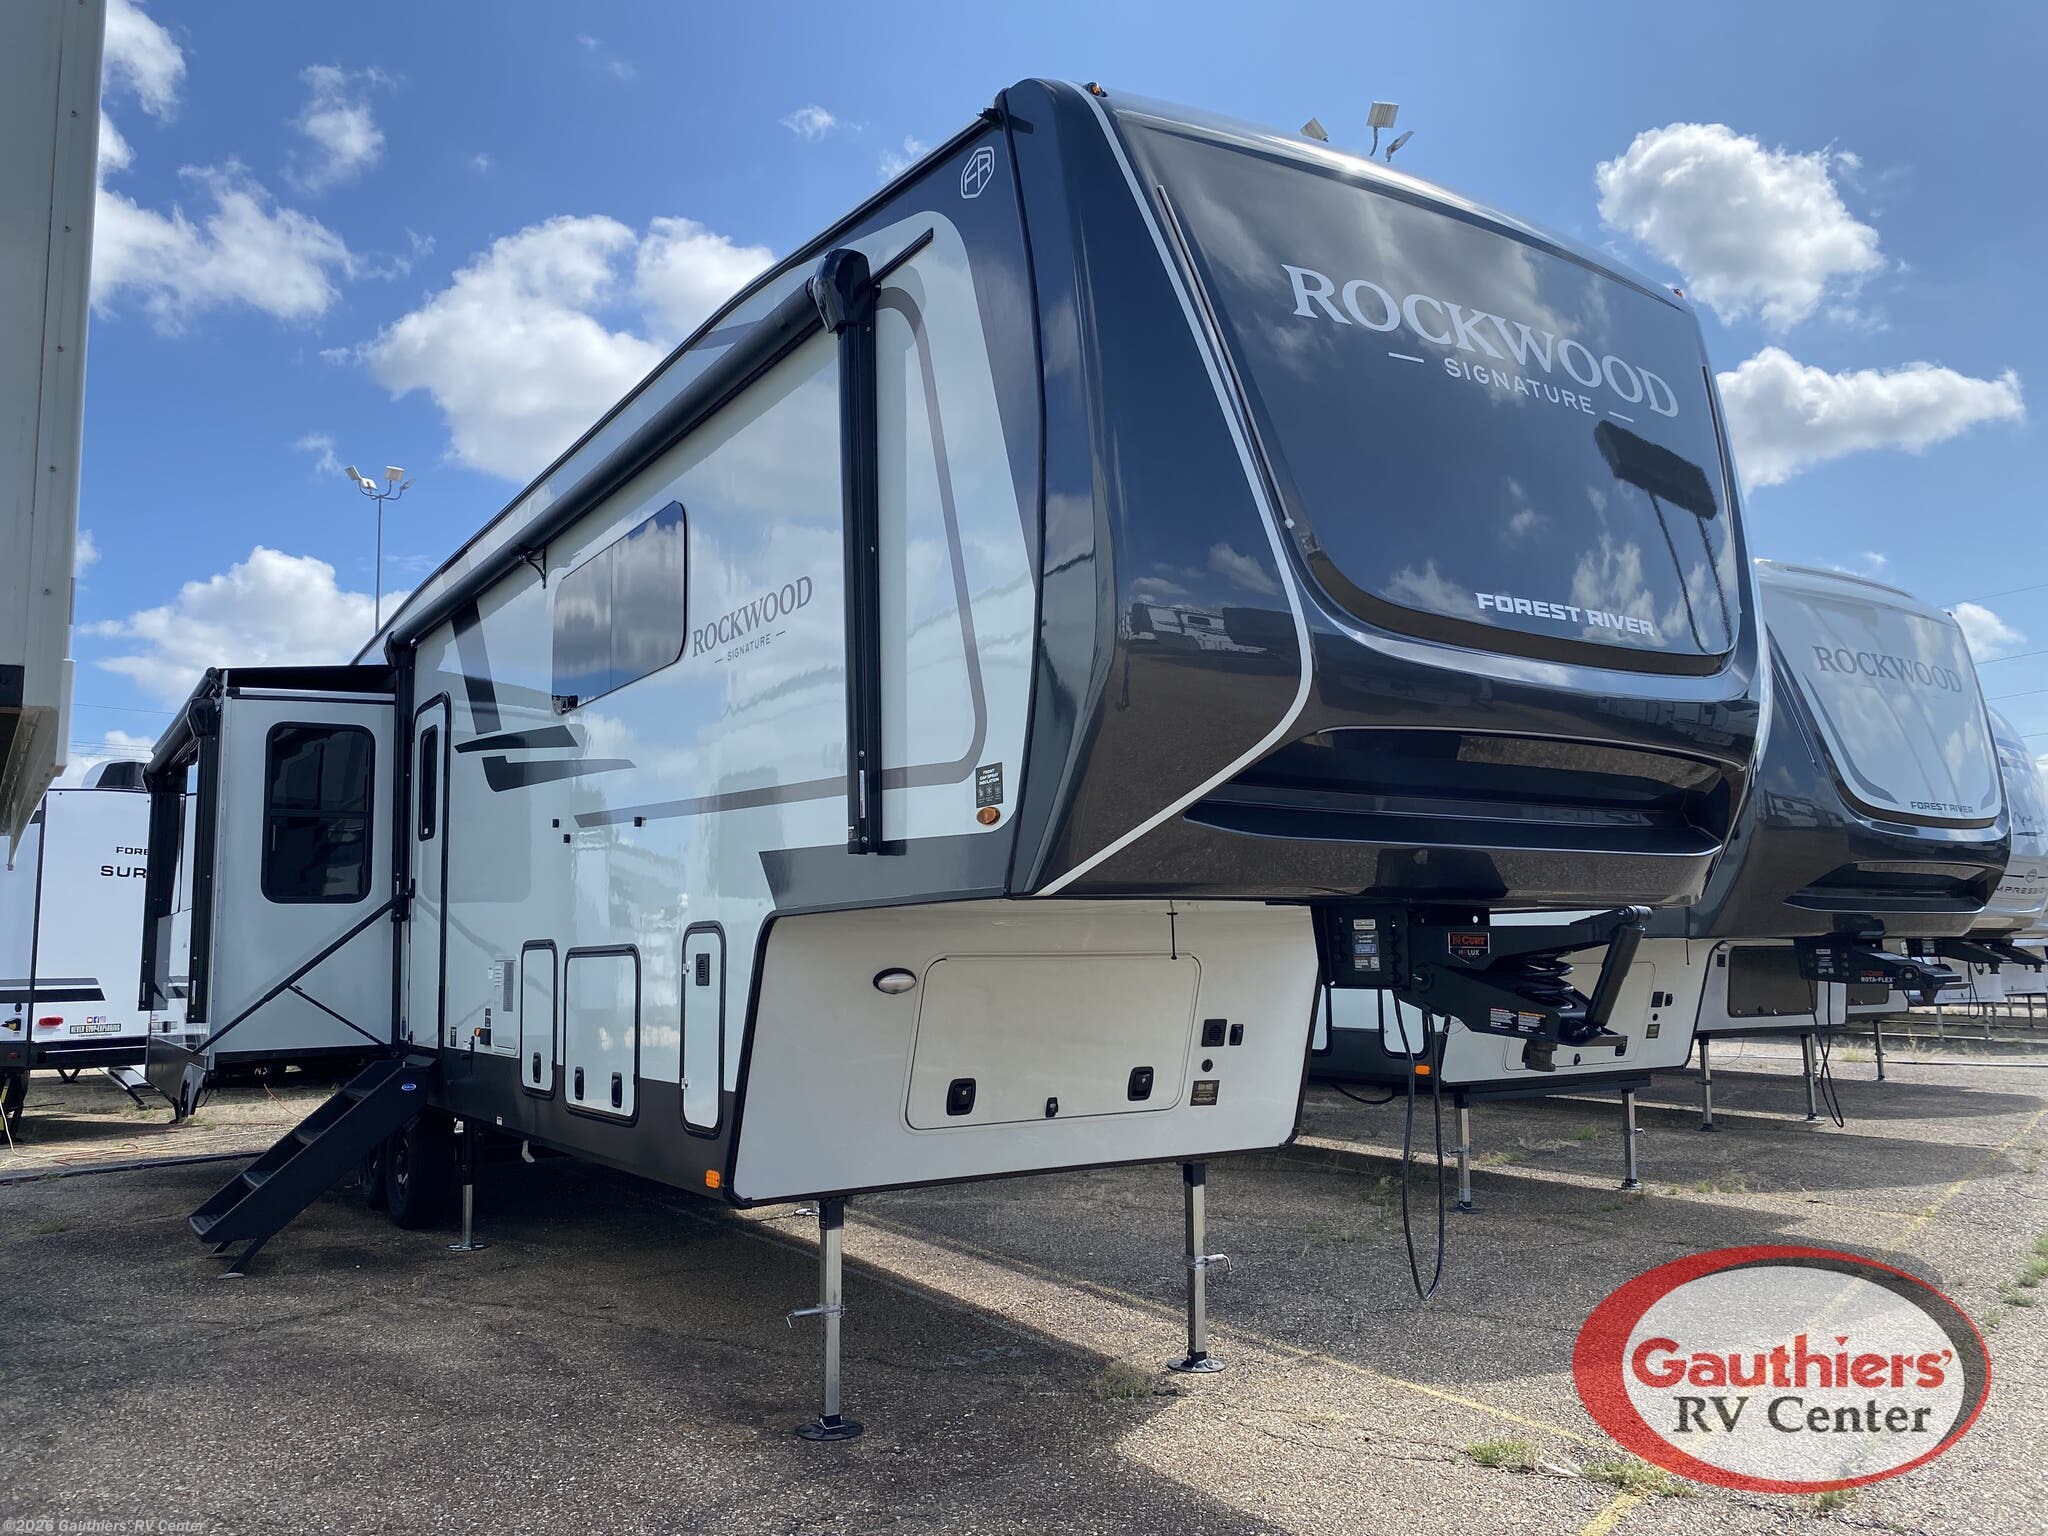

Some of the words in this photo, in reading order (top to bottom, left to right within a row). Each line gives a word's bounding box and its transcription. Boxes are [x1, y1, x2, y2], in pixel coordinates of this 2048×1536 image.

[1281, 264, 1679, 418] ROCKWOOD
[1443, 358, 1596, 415] SIGNATURE
[692, 576, 813, 658] ROCKWOOD
[1475, 592, 1581, 623] FOREST
[1585, 608, 1656, 637] RIVER
[727, 633, 772, 662] SIGNATURE
[1812, 646, 1962, 693] ROCKWOOD
[1911, 801, 1948, 811] FOREST
[1949, 804, 1974, 814] RIVER
[1461, 936, 1486, 945] CURT
